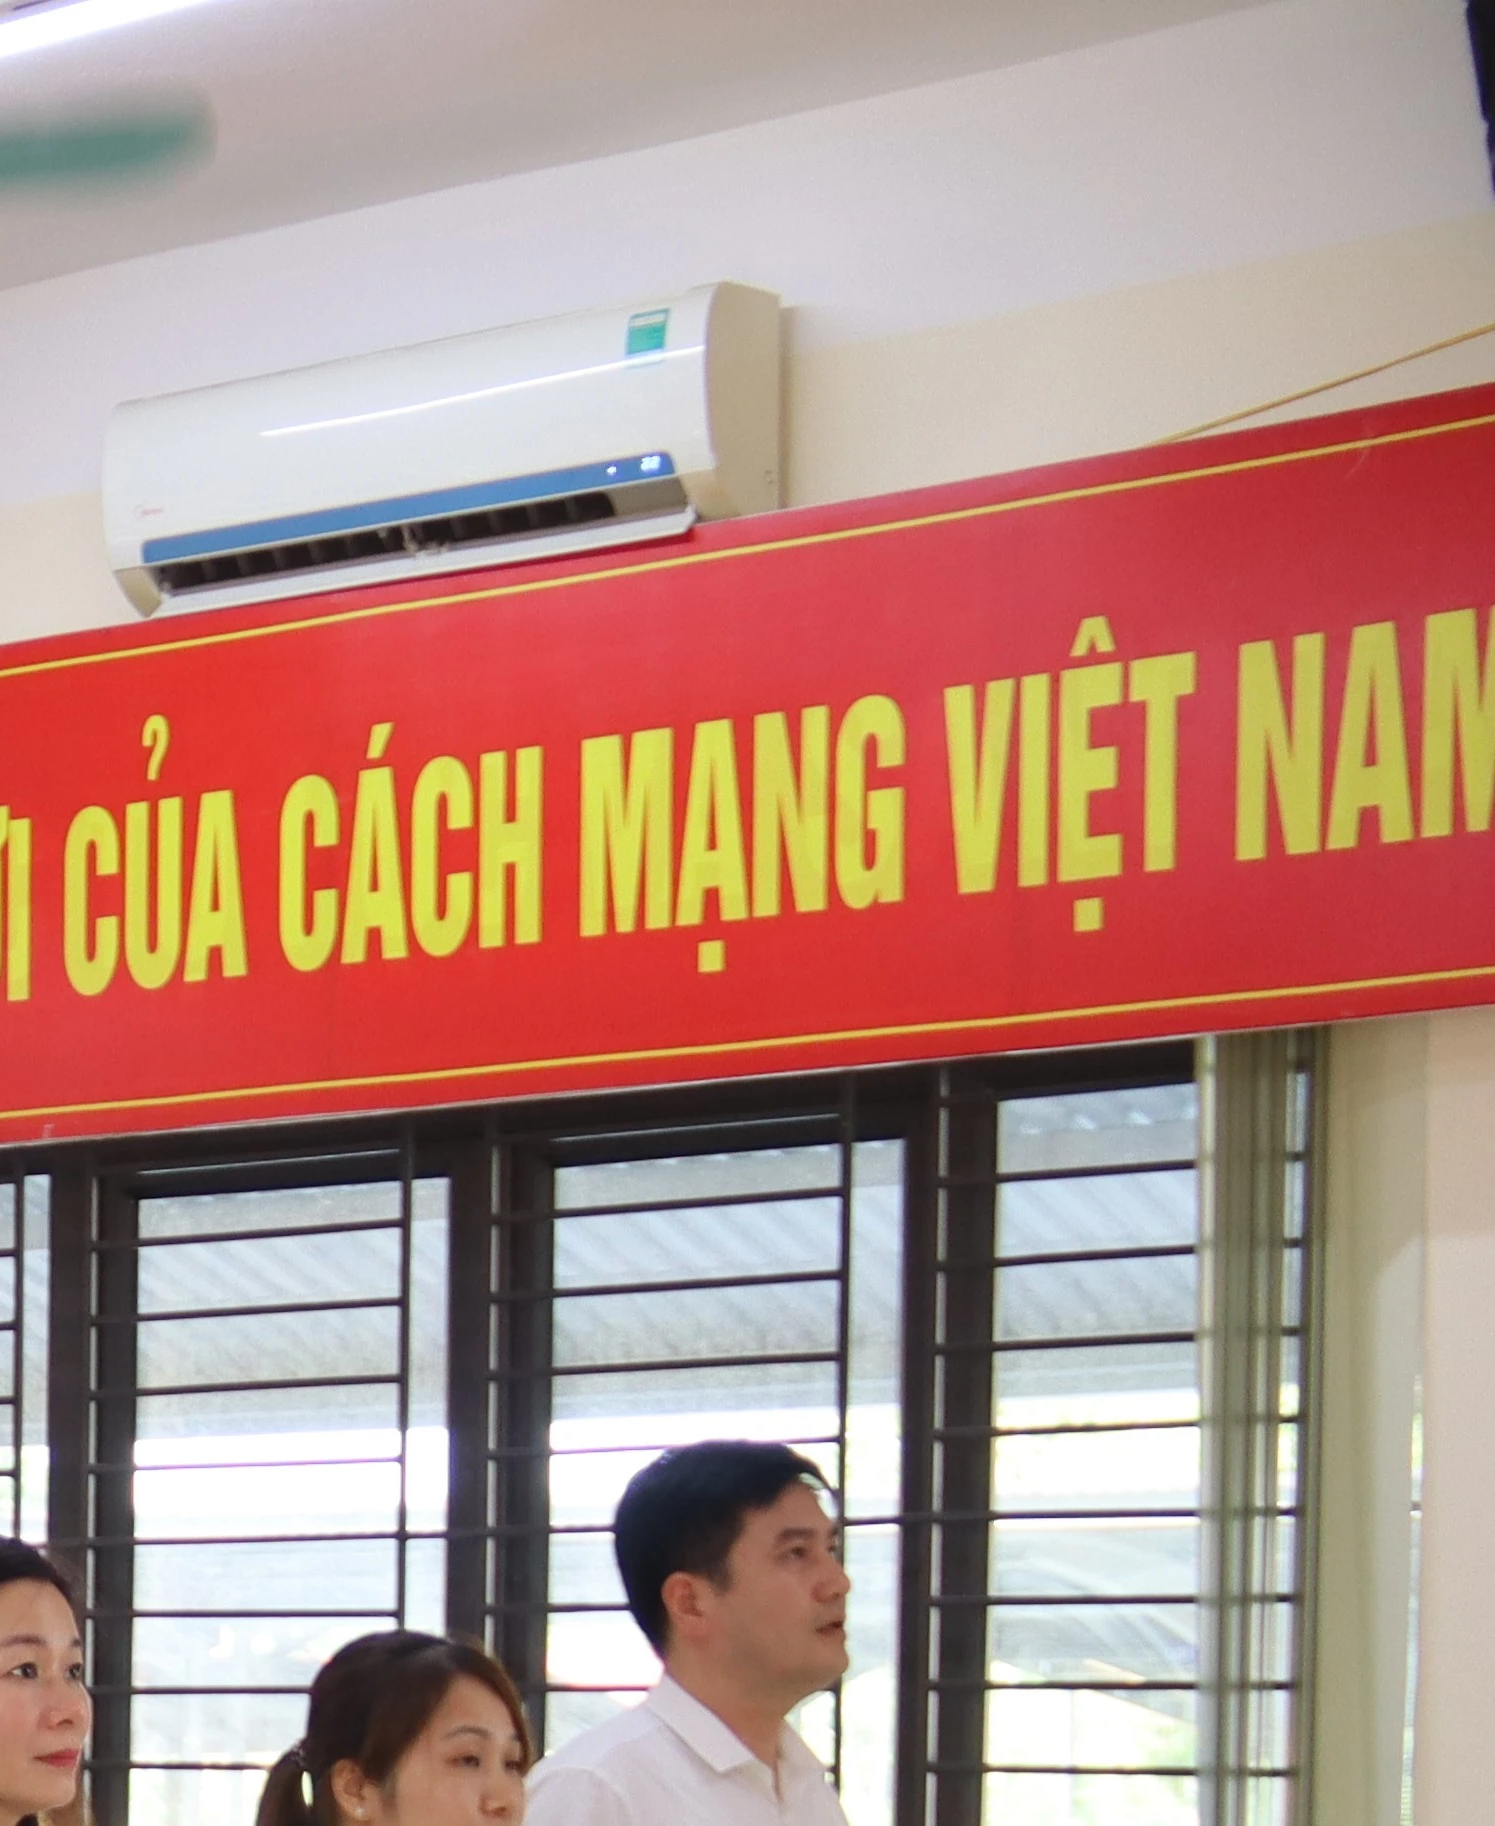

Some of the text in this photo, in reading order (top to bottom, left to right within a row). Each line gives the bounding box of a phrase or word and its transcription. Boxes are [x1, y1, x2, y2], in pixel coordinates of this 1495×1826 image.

[64, 714, 248, 996] CỦA
[279, 722, 543, 972] CÁCH
[580, 694, 906, 973] MẠNG
[944, 616, 1196, 932] VIỆT
[1236, 604, 1495, 862] NAM
